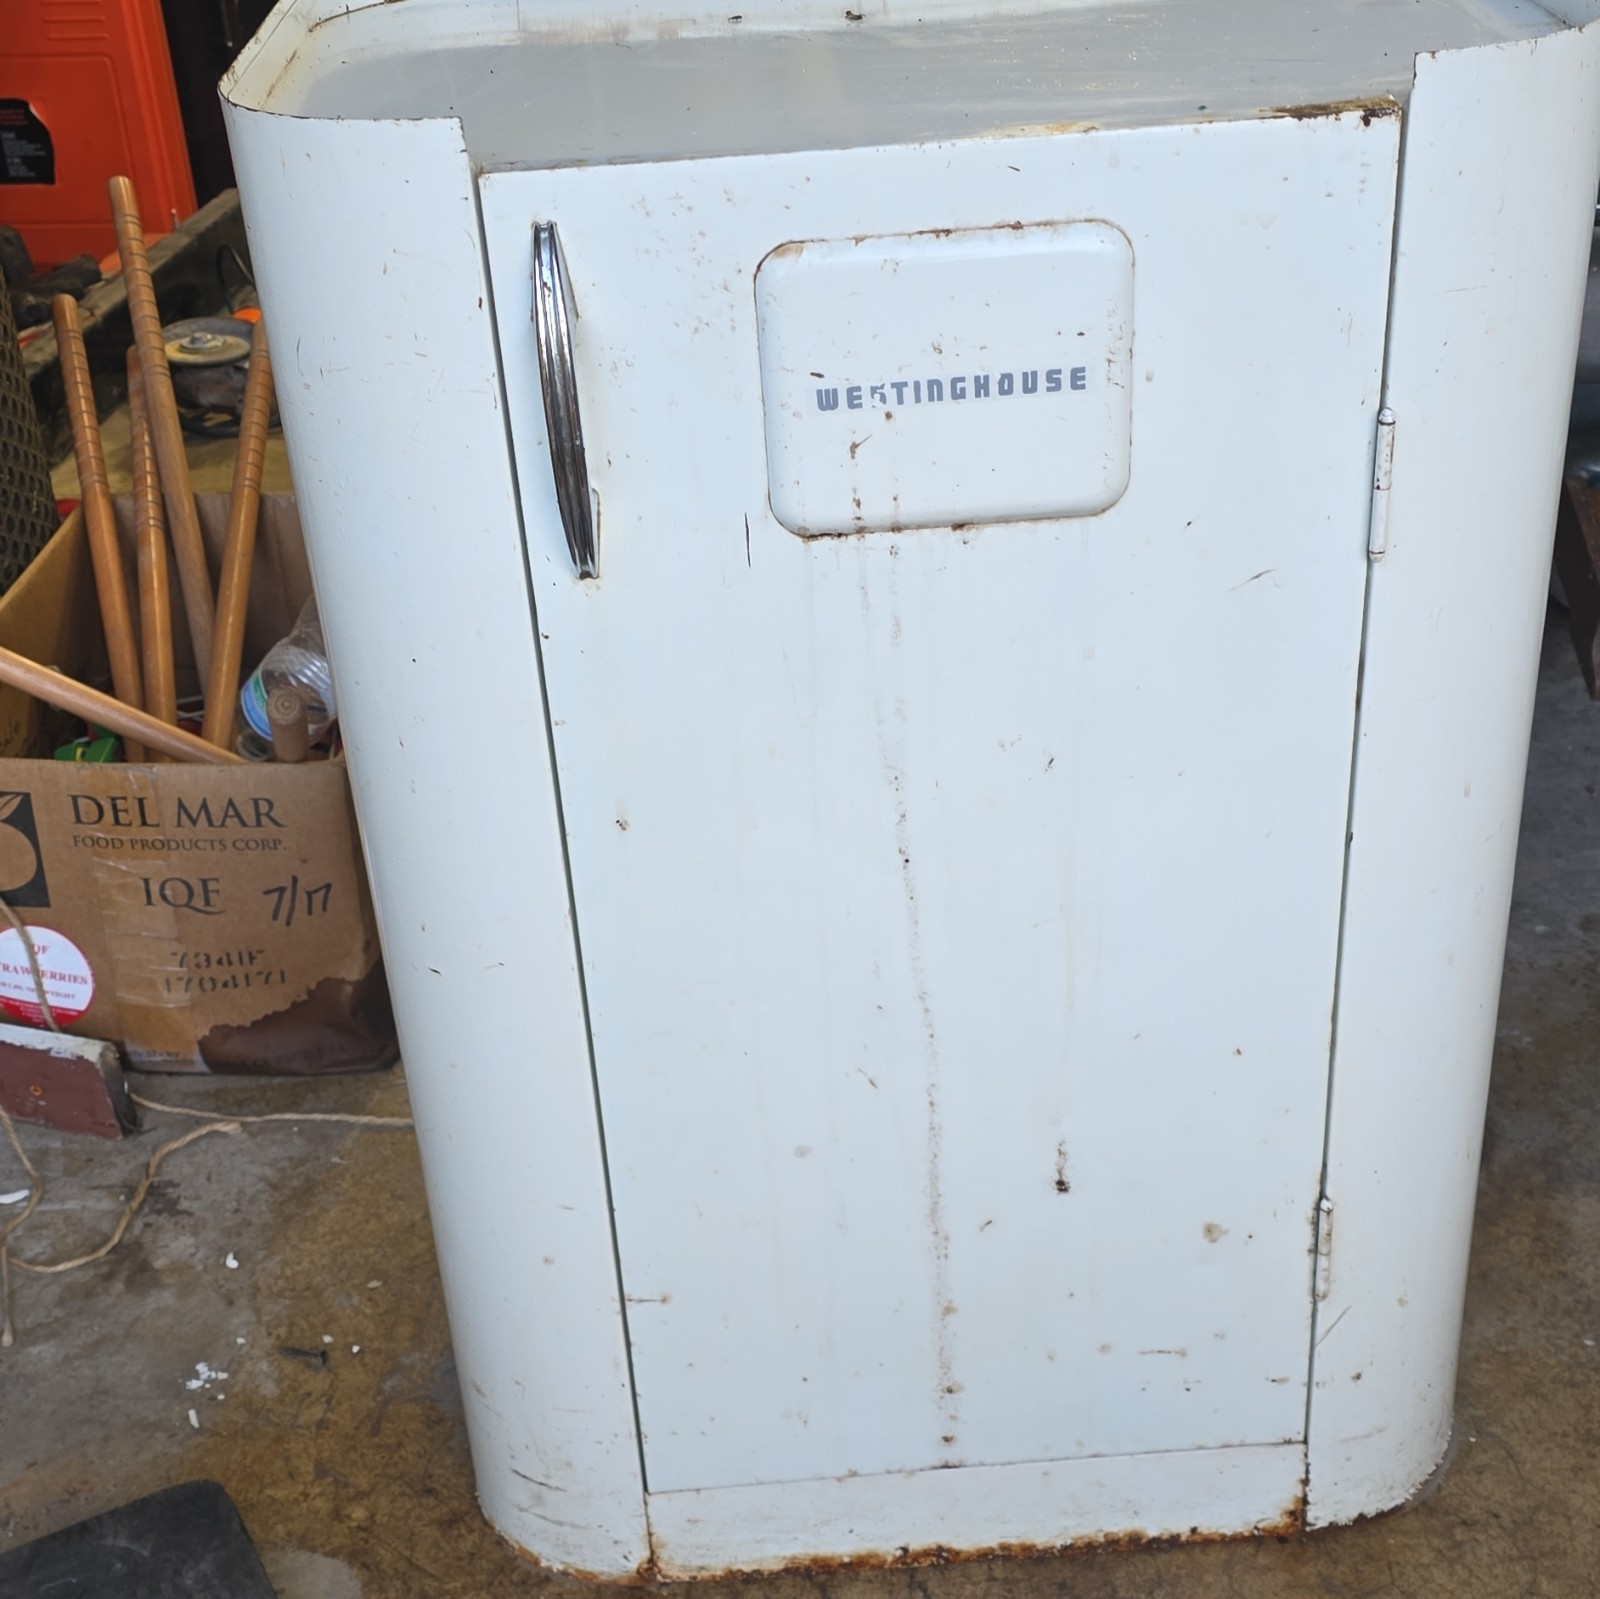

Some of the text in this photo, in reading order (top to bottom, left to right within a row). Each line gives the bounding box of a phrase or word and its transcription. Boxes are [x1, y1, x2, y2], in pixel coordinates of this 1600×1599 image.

[815, 366, 1087, 412] WESTINGHOUSE
[67, 793, 288, 829] DEL MAR
[72, 834, 288, 852] FOOD PRODUCTS CORP.
[140, 877, 226, 915] IQF
